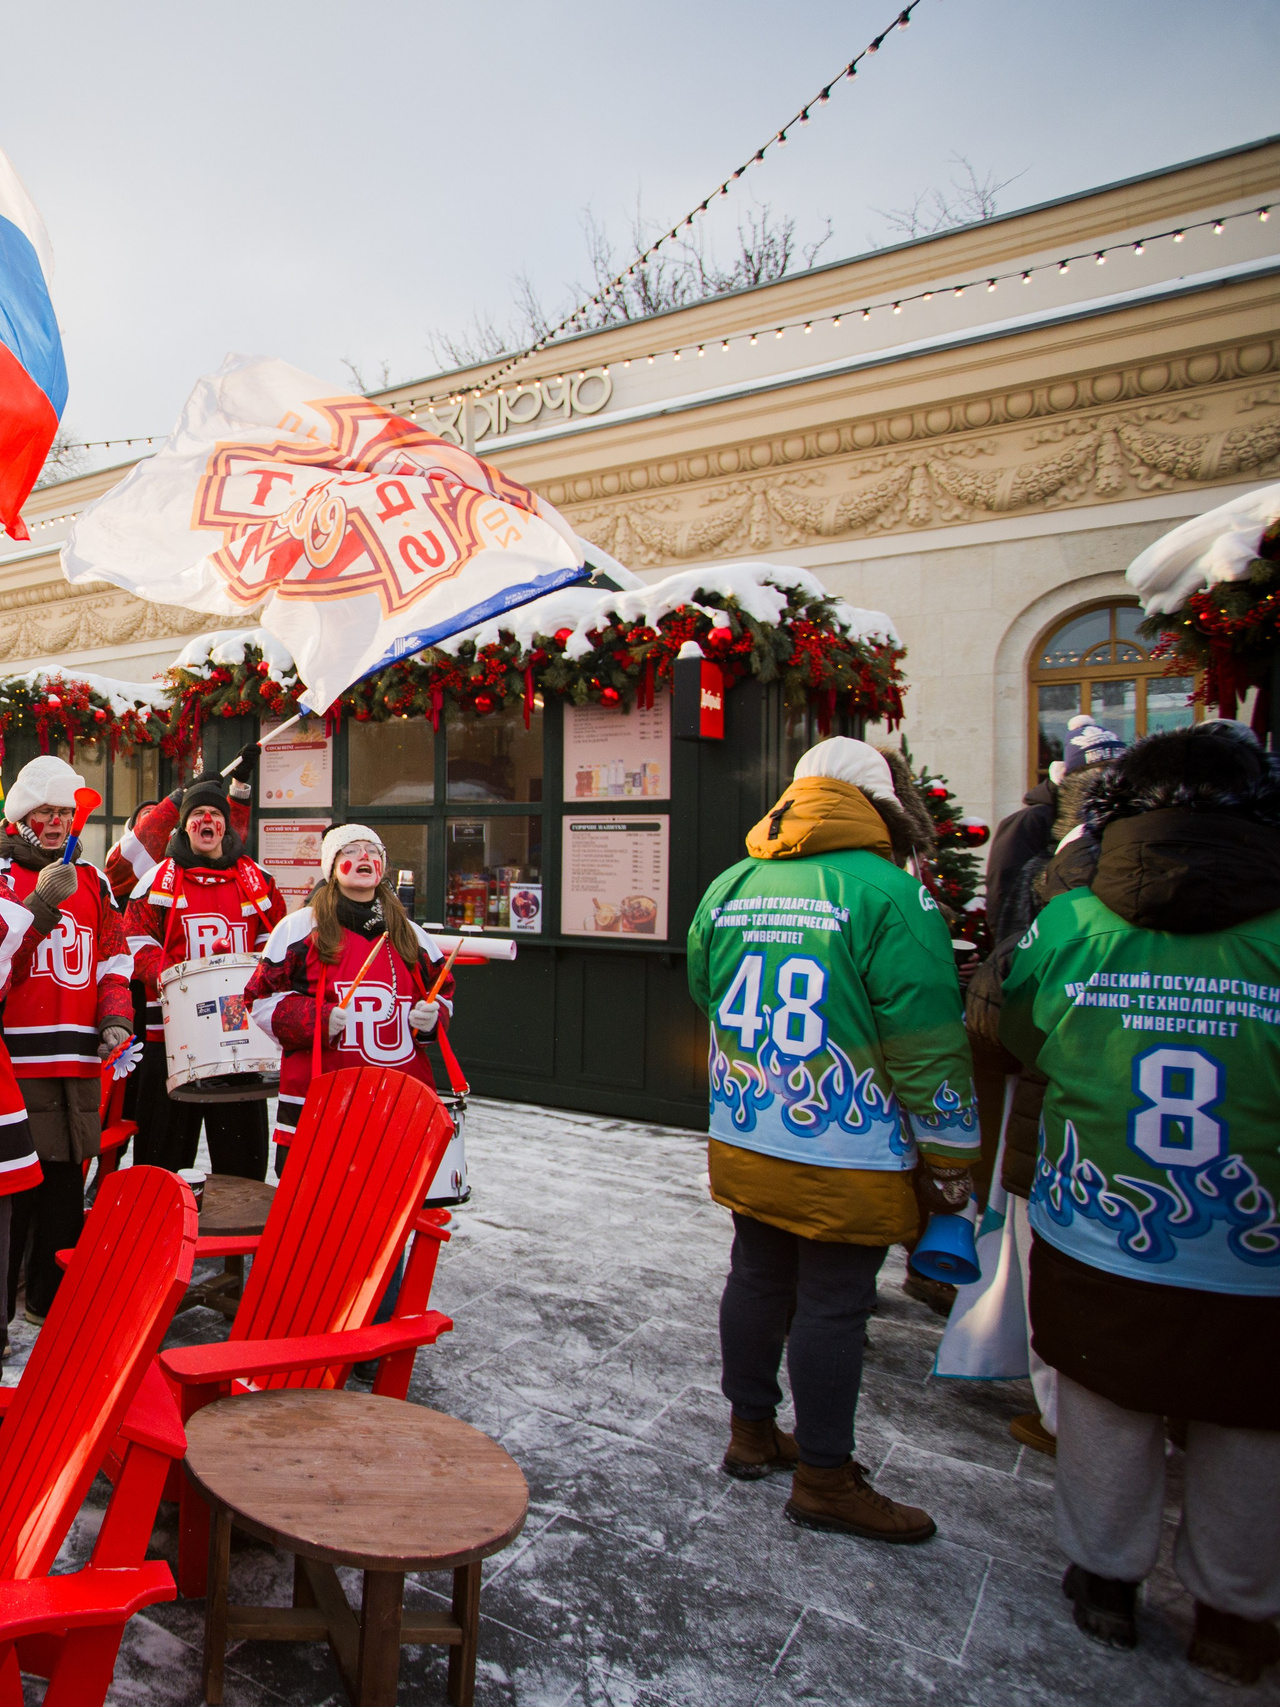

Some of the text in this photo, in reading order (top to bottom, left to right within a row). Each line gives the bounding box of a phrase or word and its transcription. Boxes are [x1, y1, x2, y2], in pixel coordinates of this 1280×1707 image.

[710, 895, 763, 921] ИОВСКИЙ
[714, 914, 843, 933] ИМИКО-ТЕХНОЛОГИЧЕСКИ
[742, 930, 805, 945] УНИВЕРСИТЕТ
[1065, 971, 1150, 998] ИВОВСКИЙ
[716, 950, 830, 1061] 48
[1121, 1014, 1239, 1038] УНИВЕРСИТЕТ
[1126, 1042, 1230, 1171] 8
